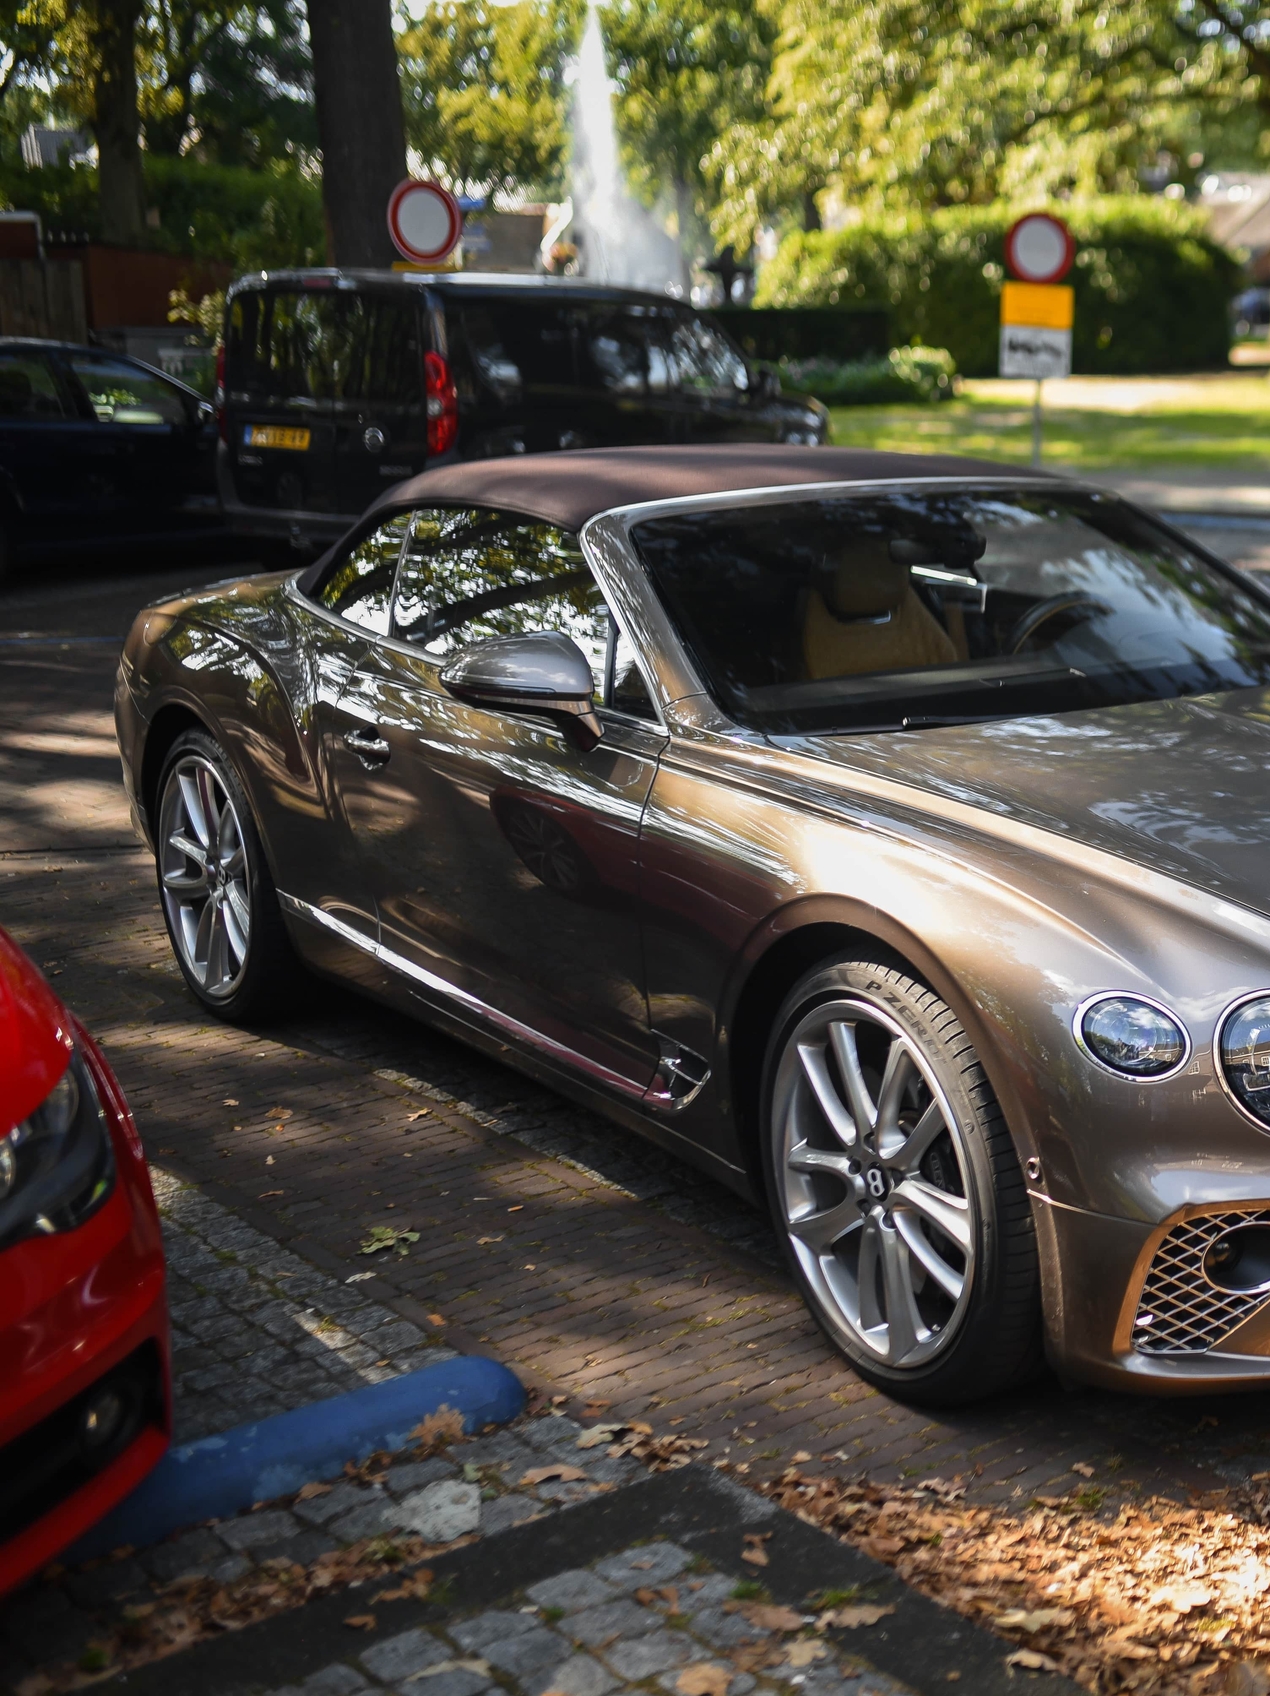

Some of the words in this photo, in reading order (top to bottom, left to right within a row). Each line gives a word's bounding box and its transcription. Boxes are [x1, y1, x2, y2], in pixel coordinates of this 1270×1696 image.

[865, 980, 882, 991] P
[883, 991, 942, 1061] ZERO
[866, 1168, 885, 1197] B
